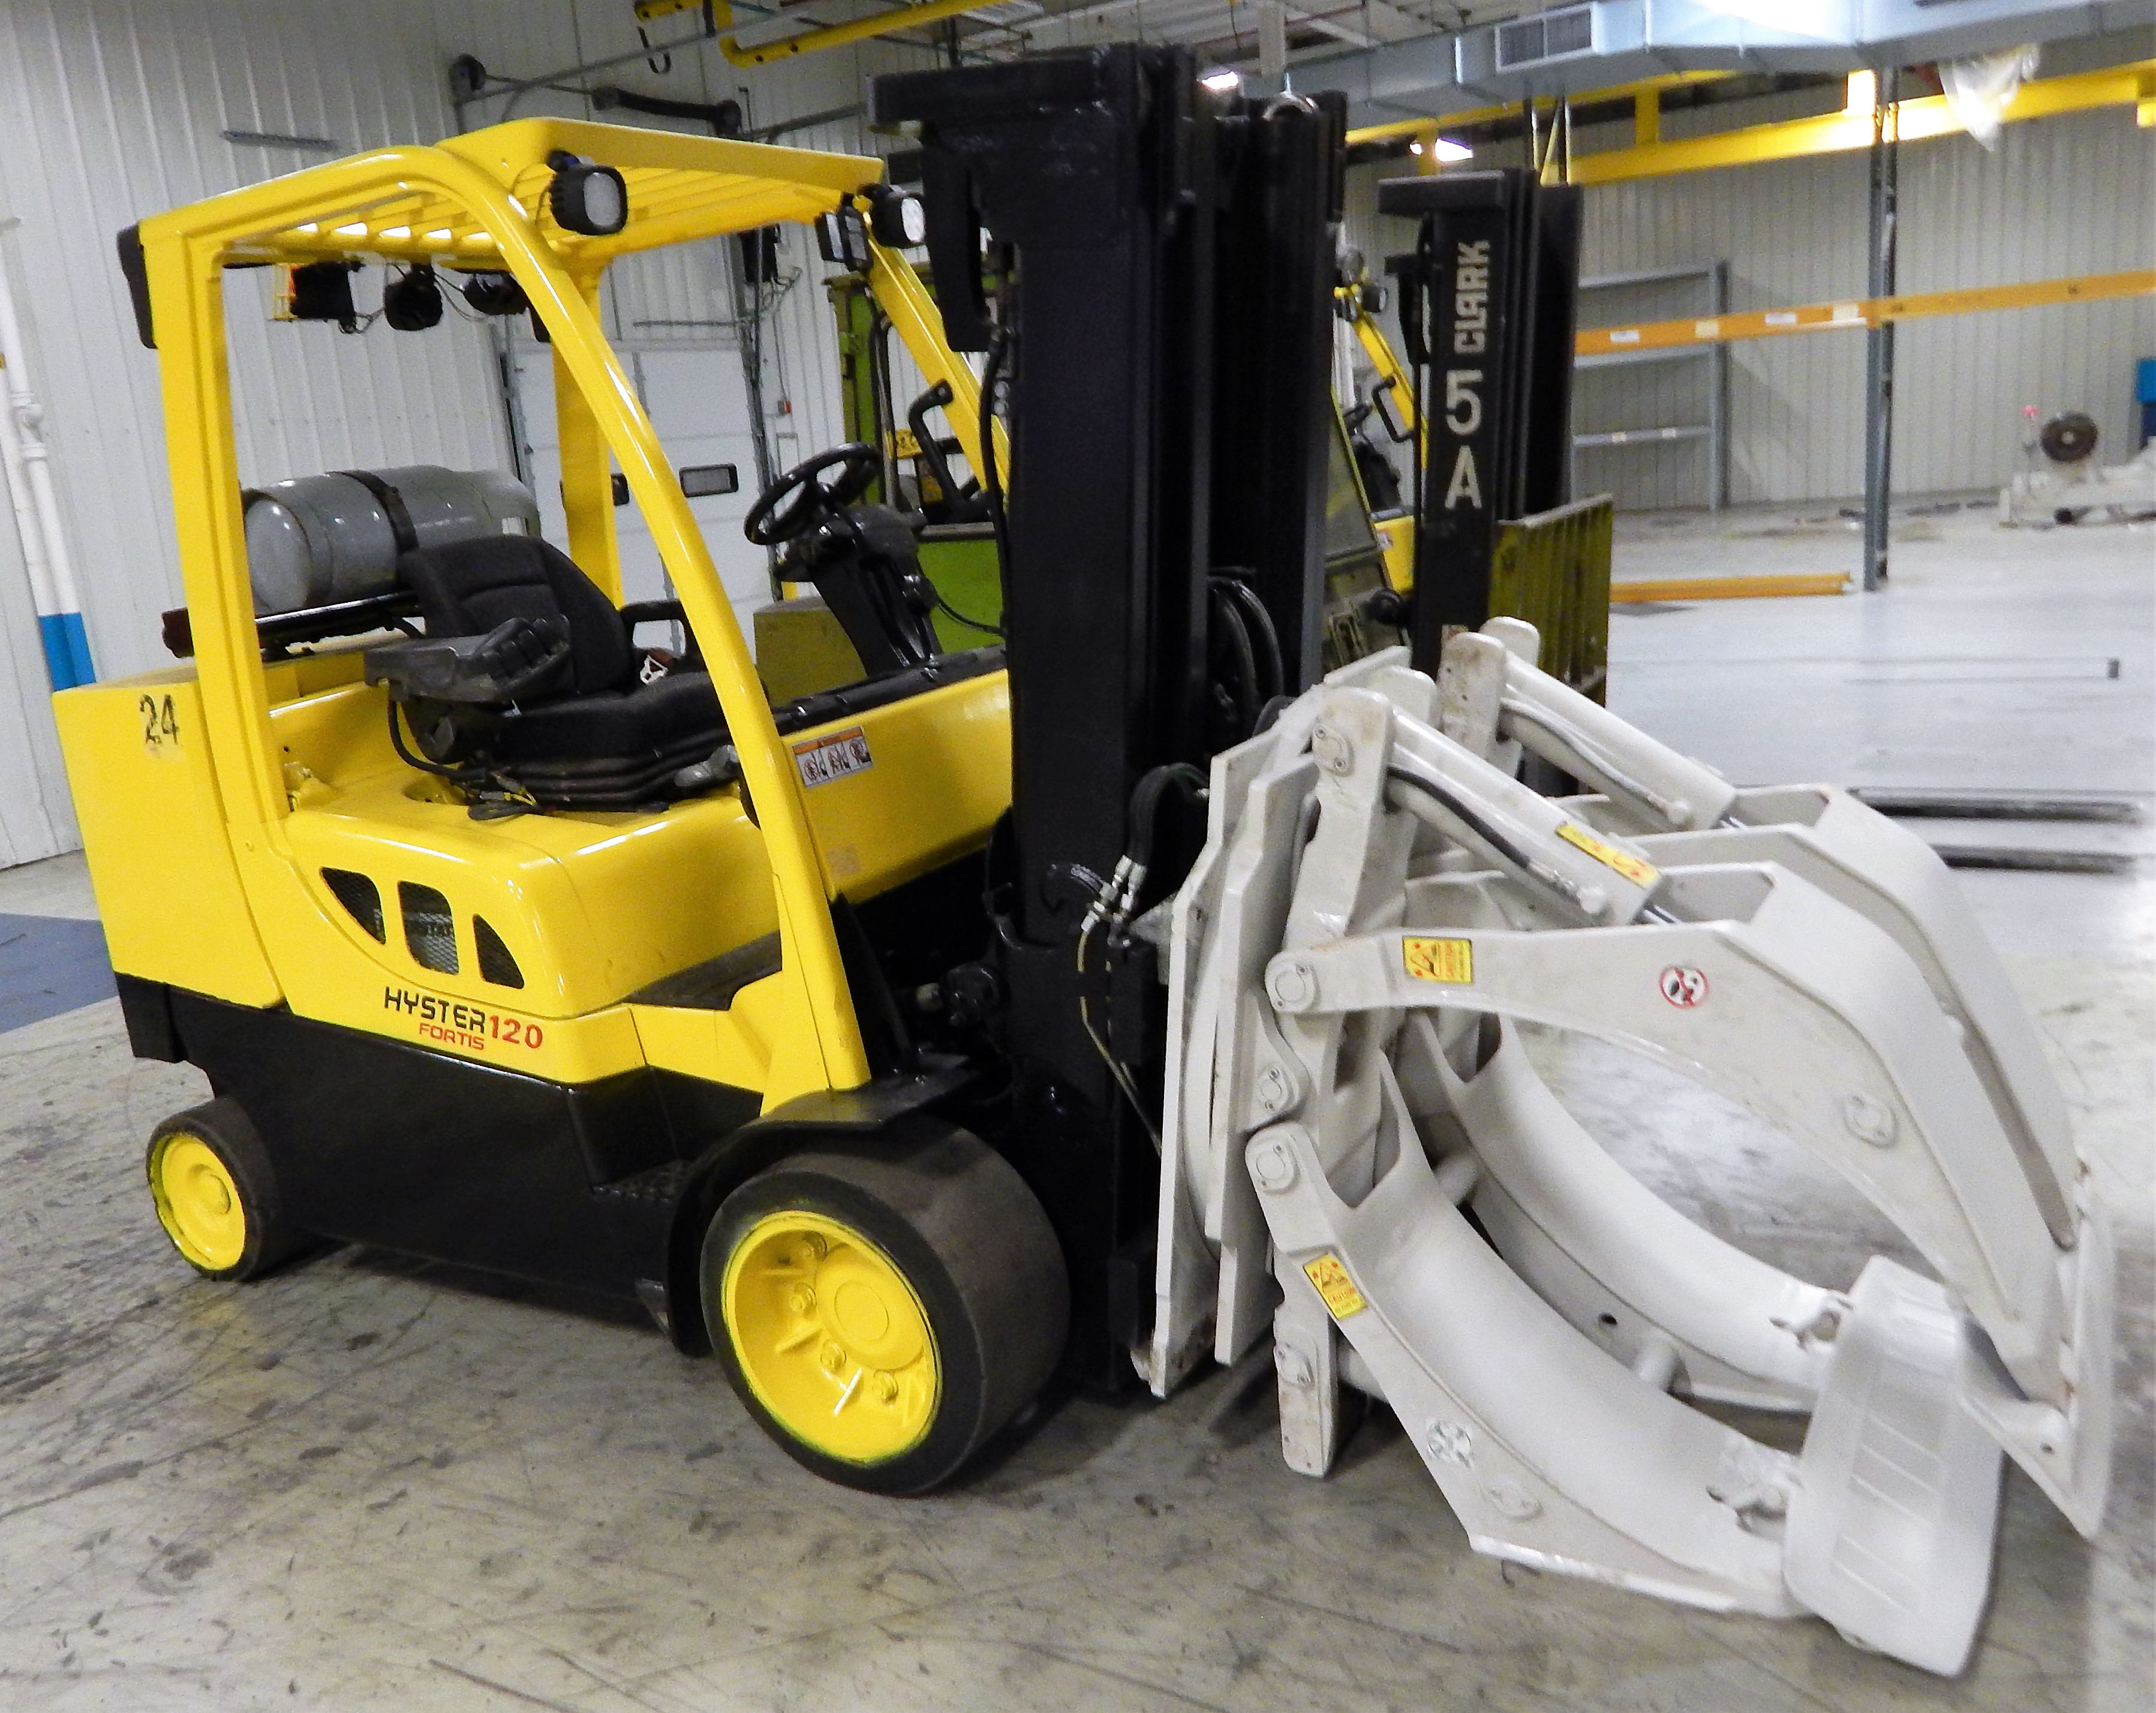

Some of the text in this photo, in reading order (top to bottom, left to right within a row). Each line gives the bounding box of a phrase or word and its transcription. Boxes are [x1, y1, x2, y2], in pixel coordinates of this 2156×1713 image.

[1454, 240, 1490, 354] CLARK
[1446, 369, 1483, 435] 5
[1445, 445, 1482, 509] A
[139, 693, 178, 745] 24
[384, 986, 543, 1048] HYSTER 120
[419, 1021, 485, 1050] FORTIS
